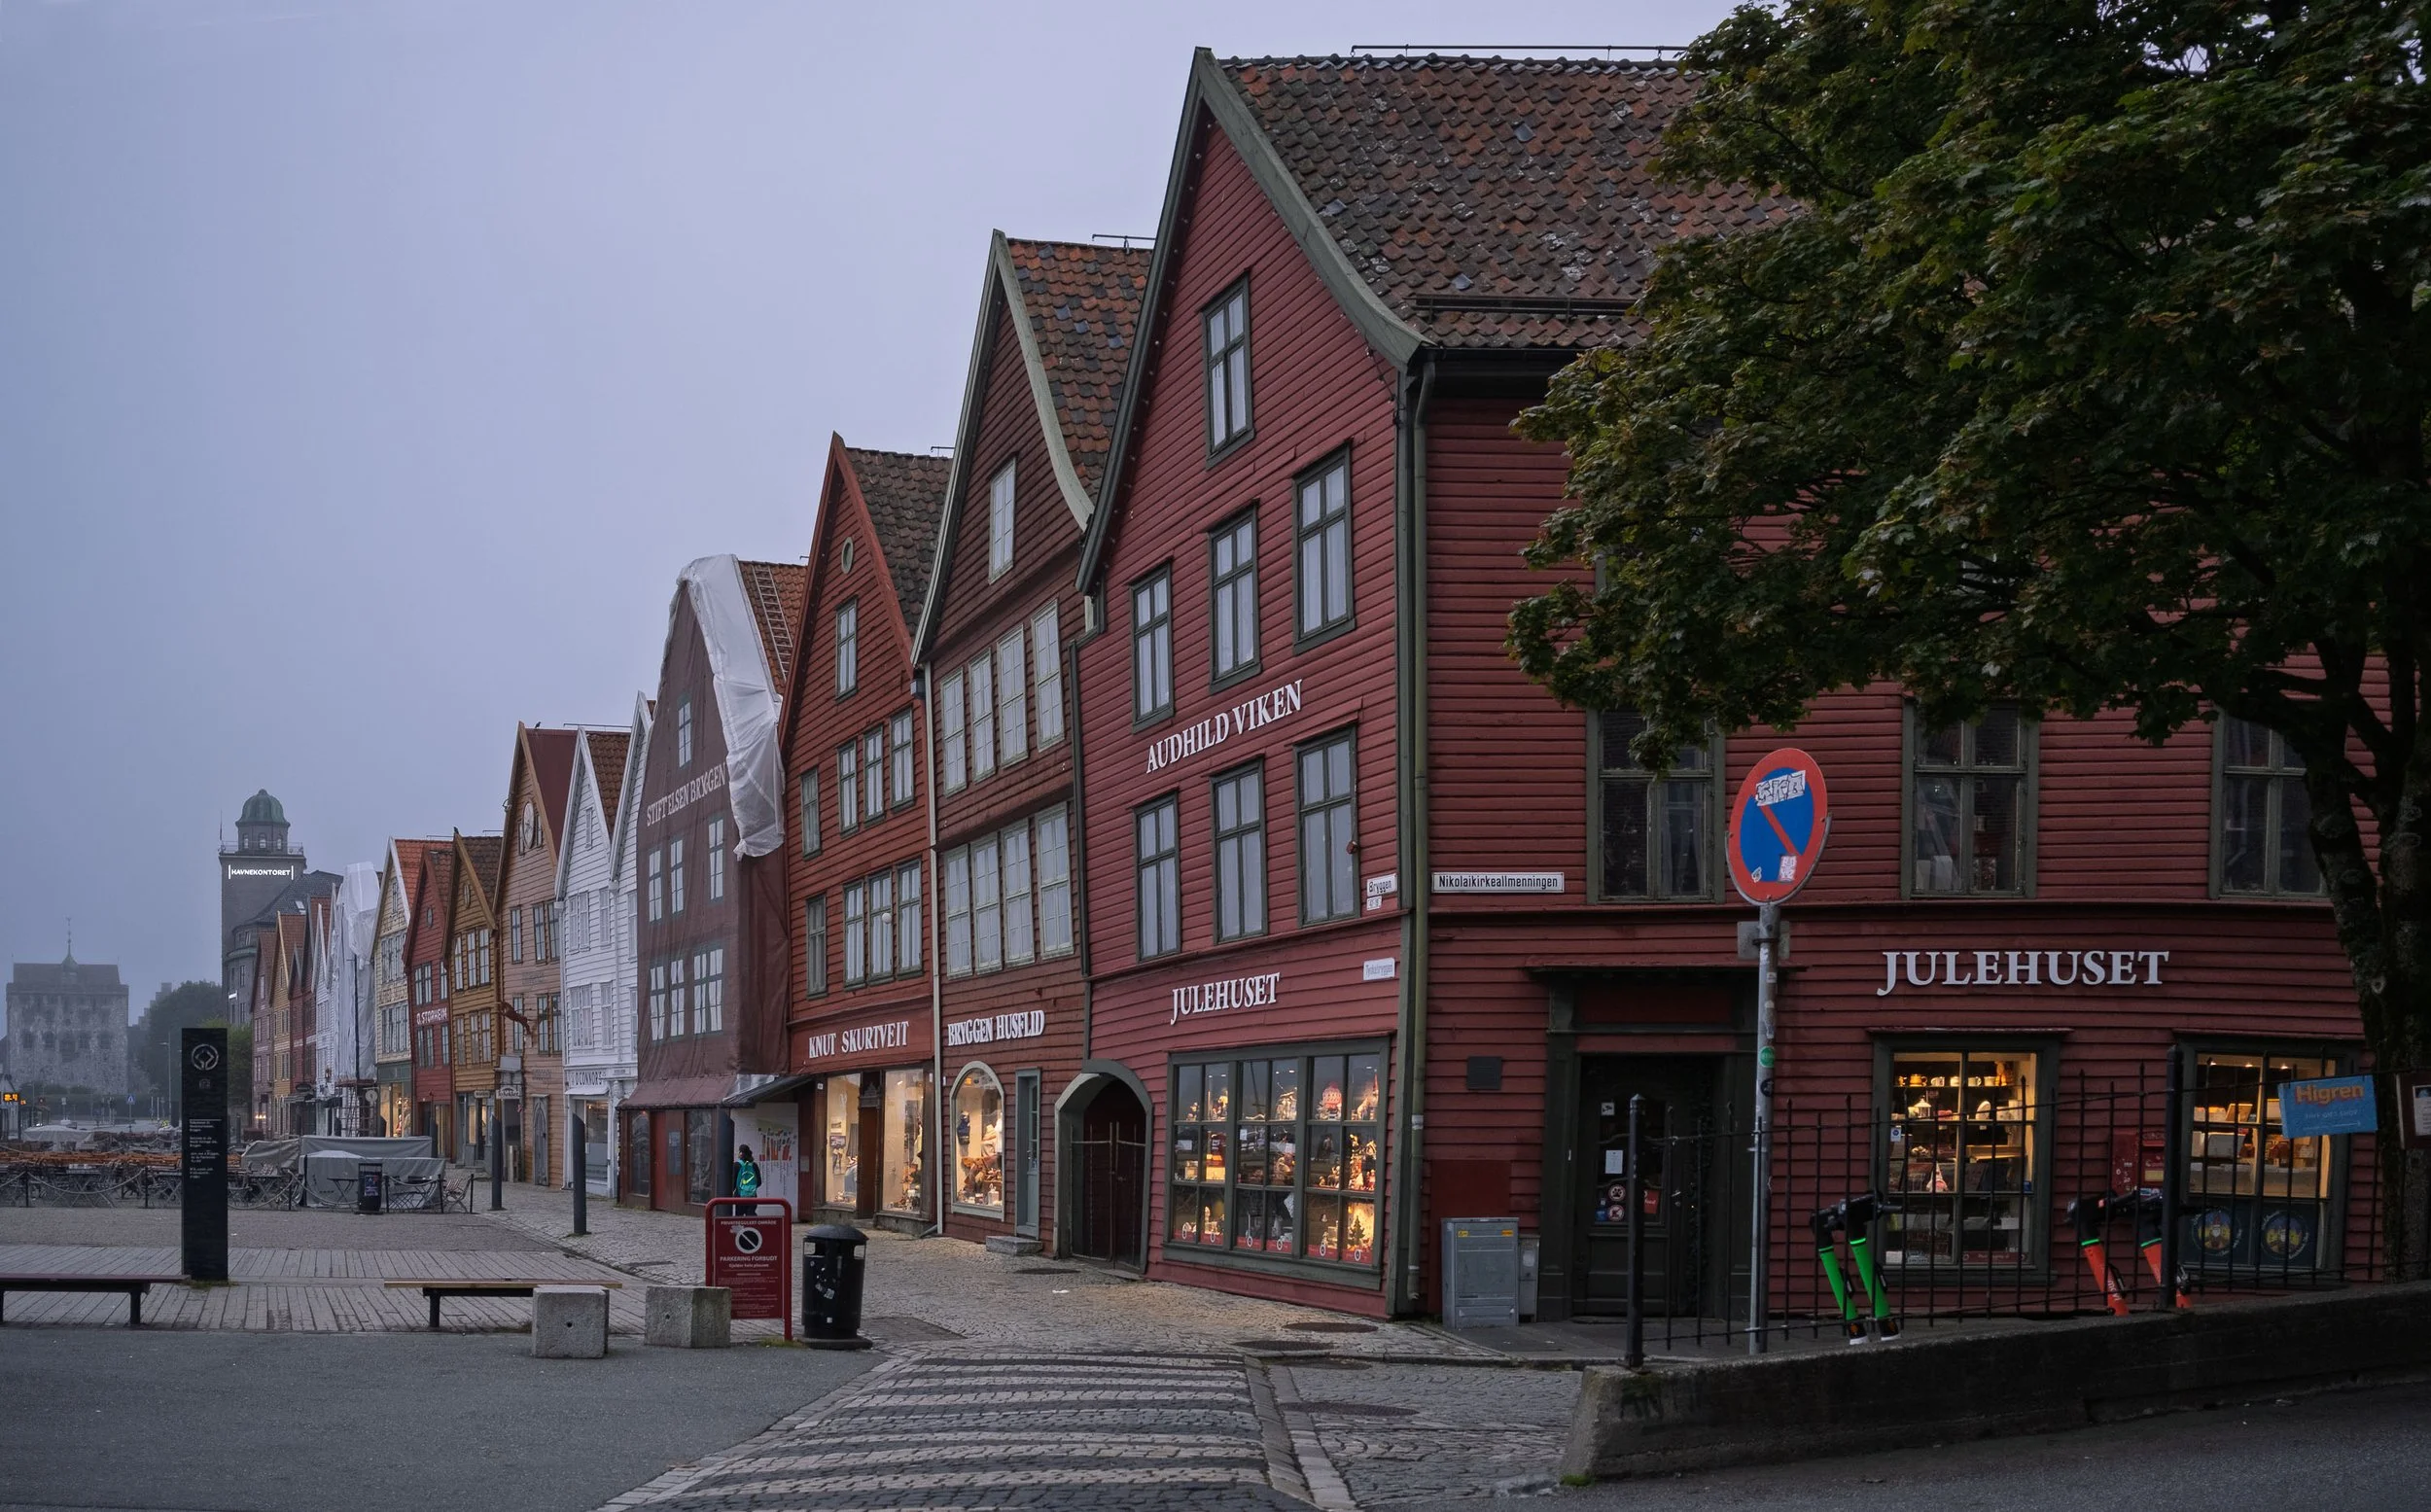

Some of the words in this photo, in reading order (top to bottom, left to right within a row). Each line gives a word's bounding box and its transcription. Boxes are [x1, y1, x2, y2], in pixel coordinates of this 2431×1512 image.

[1146, 712, 1230, 774] AUDHILD
[1232, 679, 1303, 735] VIKEN
[1368, 879, 1392, 894] Bryggen
[1439, 875, 1558, 890] Nikolaikirkeallmenningen
[1876, 950, 2170, 997] JULEHUSET
[1170, 971, 1281, 1026] JULEHUSET
[809, 1033, 837, 1059] KNUT
[841, 1021, 910, 1053] SKURTVEIT
[947, 1017, 994, 1046] BRYGGEN
[995, 1009, 1045, 1040] HUSFLID
[2295, 1083, 2365, 1107] Higren
